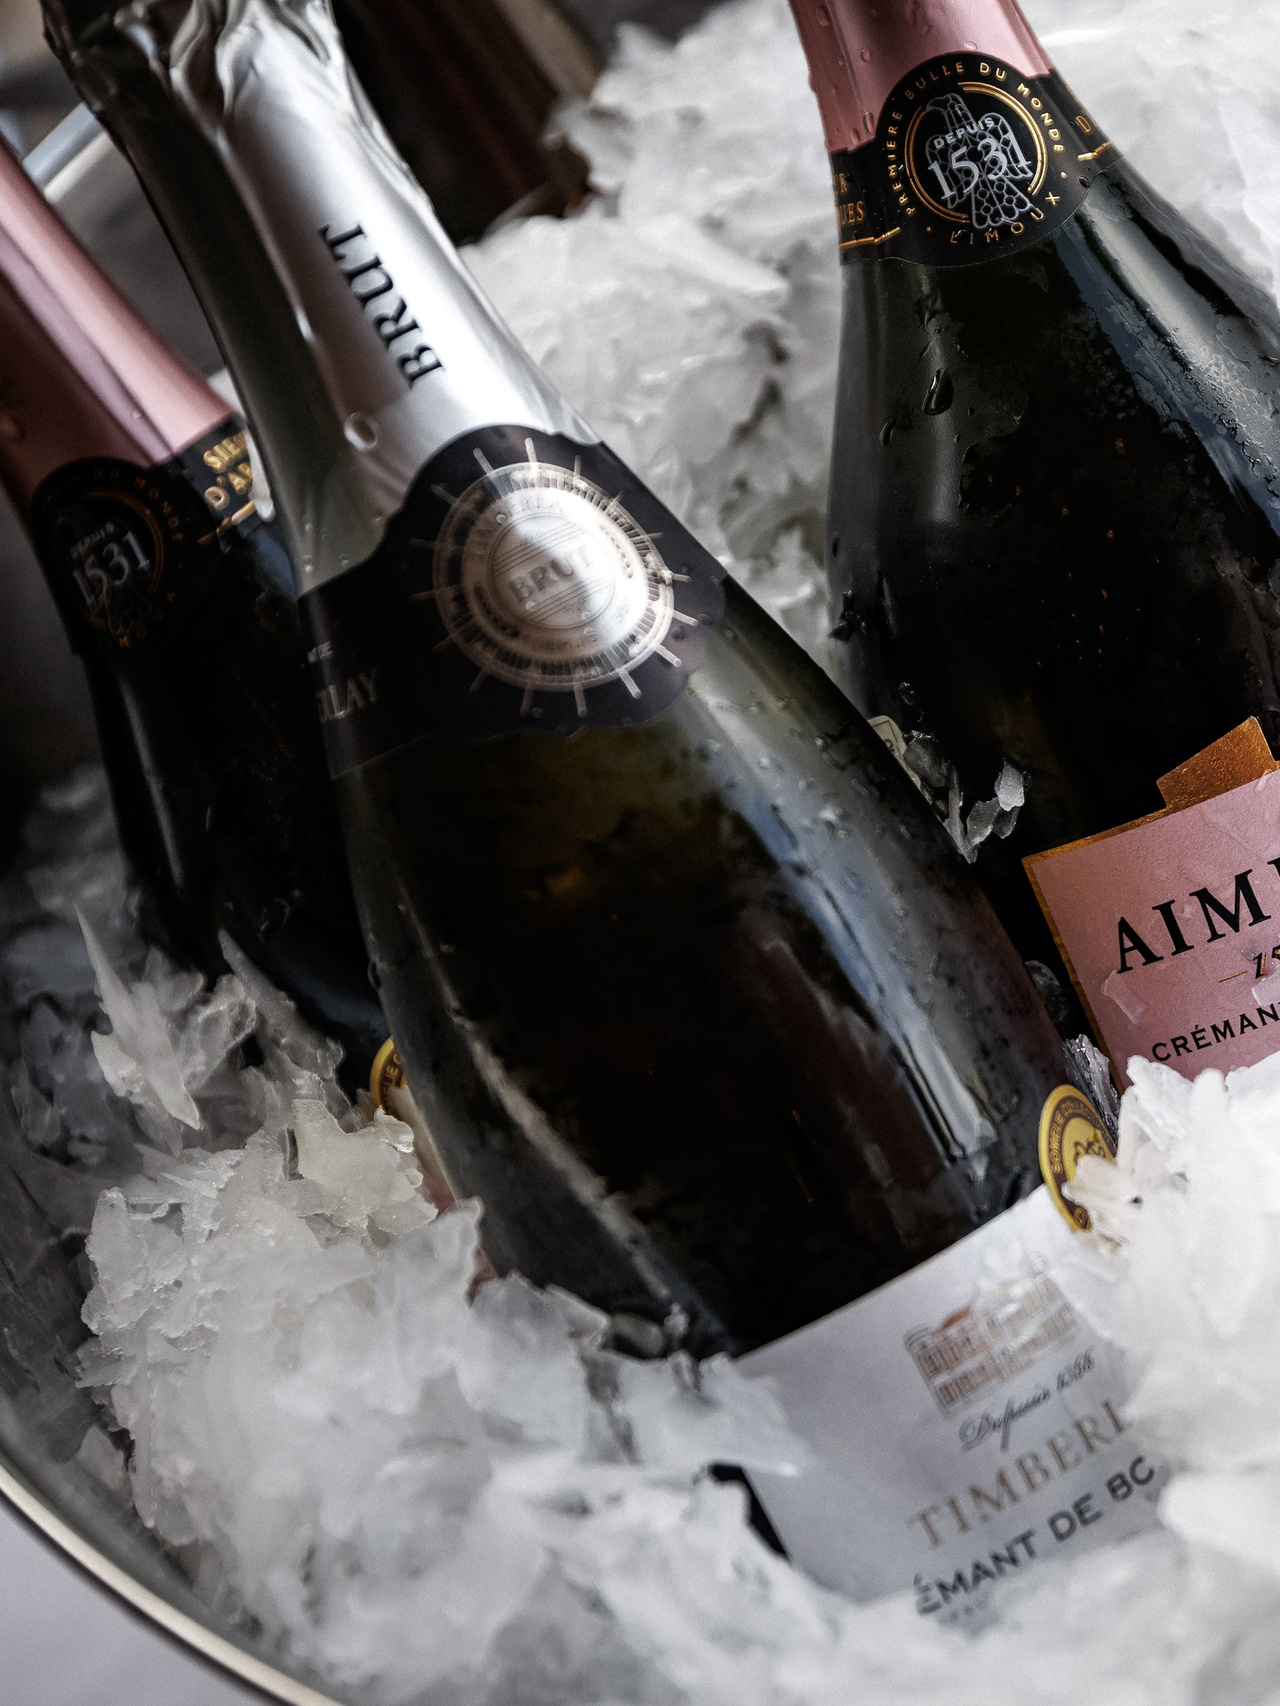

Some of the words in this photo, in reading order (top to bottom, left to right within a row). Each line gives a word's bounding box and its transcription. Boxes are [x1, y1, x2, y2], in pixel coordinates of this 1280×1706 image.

[885, 110, 917, 217] PREMIERE
[904, 61, 965, 101] BULLE
[978, 61, 1007, 81] DU
[1016, 82, 1064, 153] MONDE
[934, 117, 996, 150] DEPUIS
[926, 131, 1033, 200] 1531
[949, 190, 1061, 245] LIMOUX
[318, 224, 444, 390] BRUT
[71, 530, 151, 614] 1531
[508, 545, 593, 602] BRUT
[1046, 1493, 1104, 1544] DE
